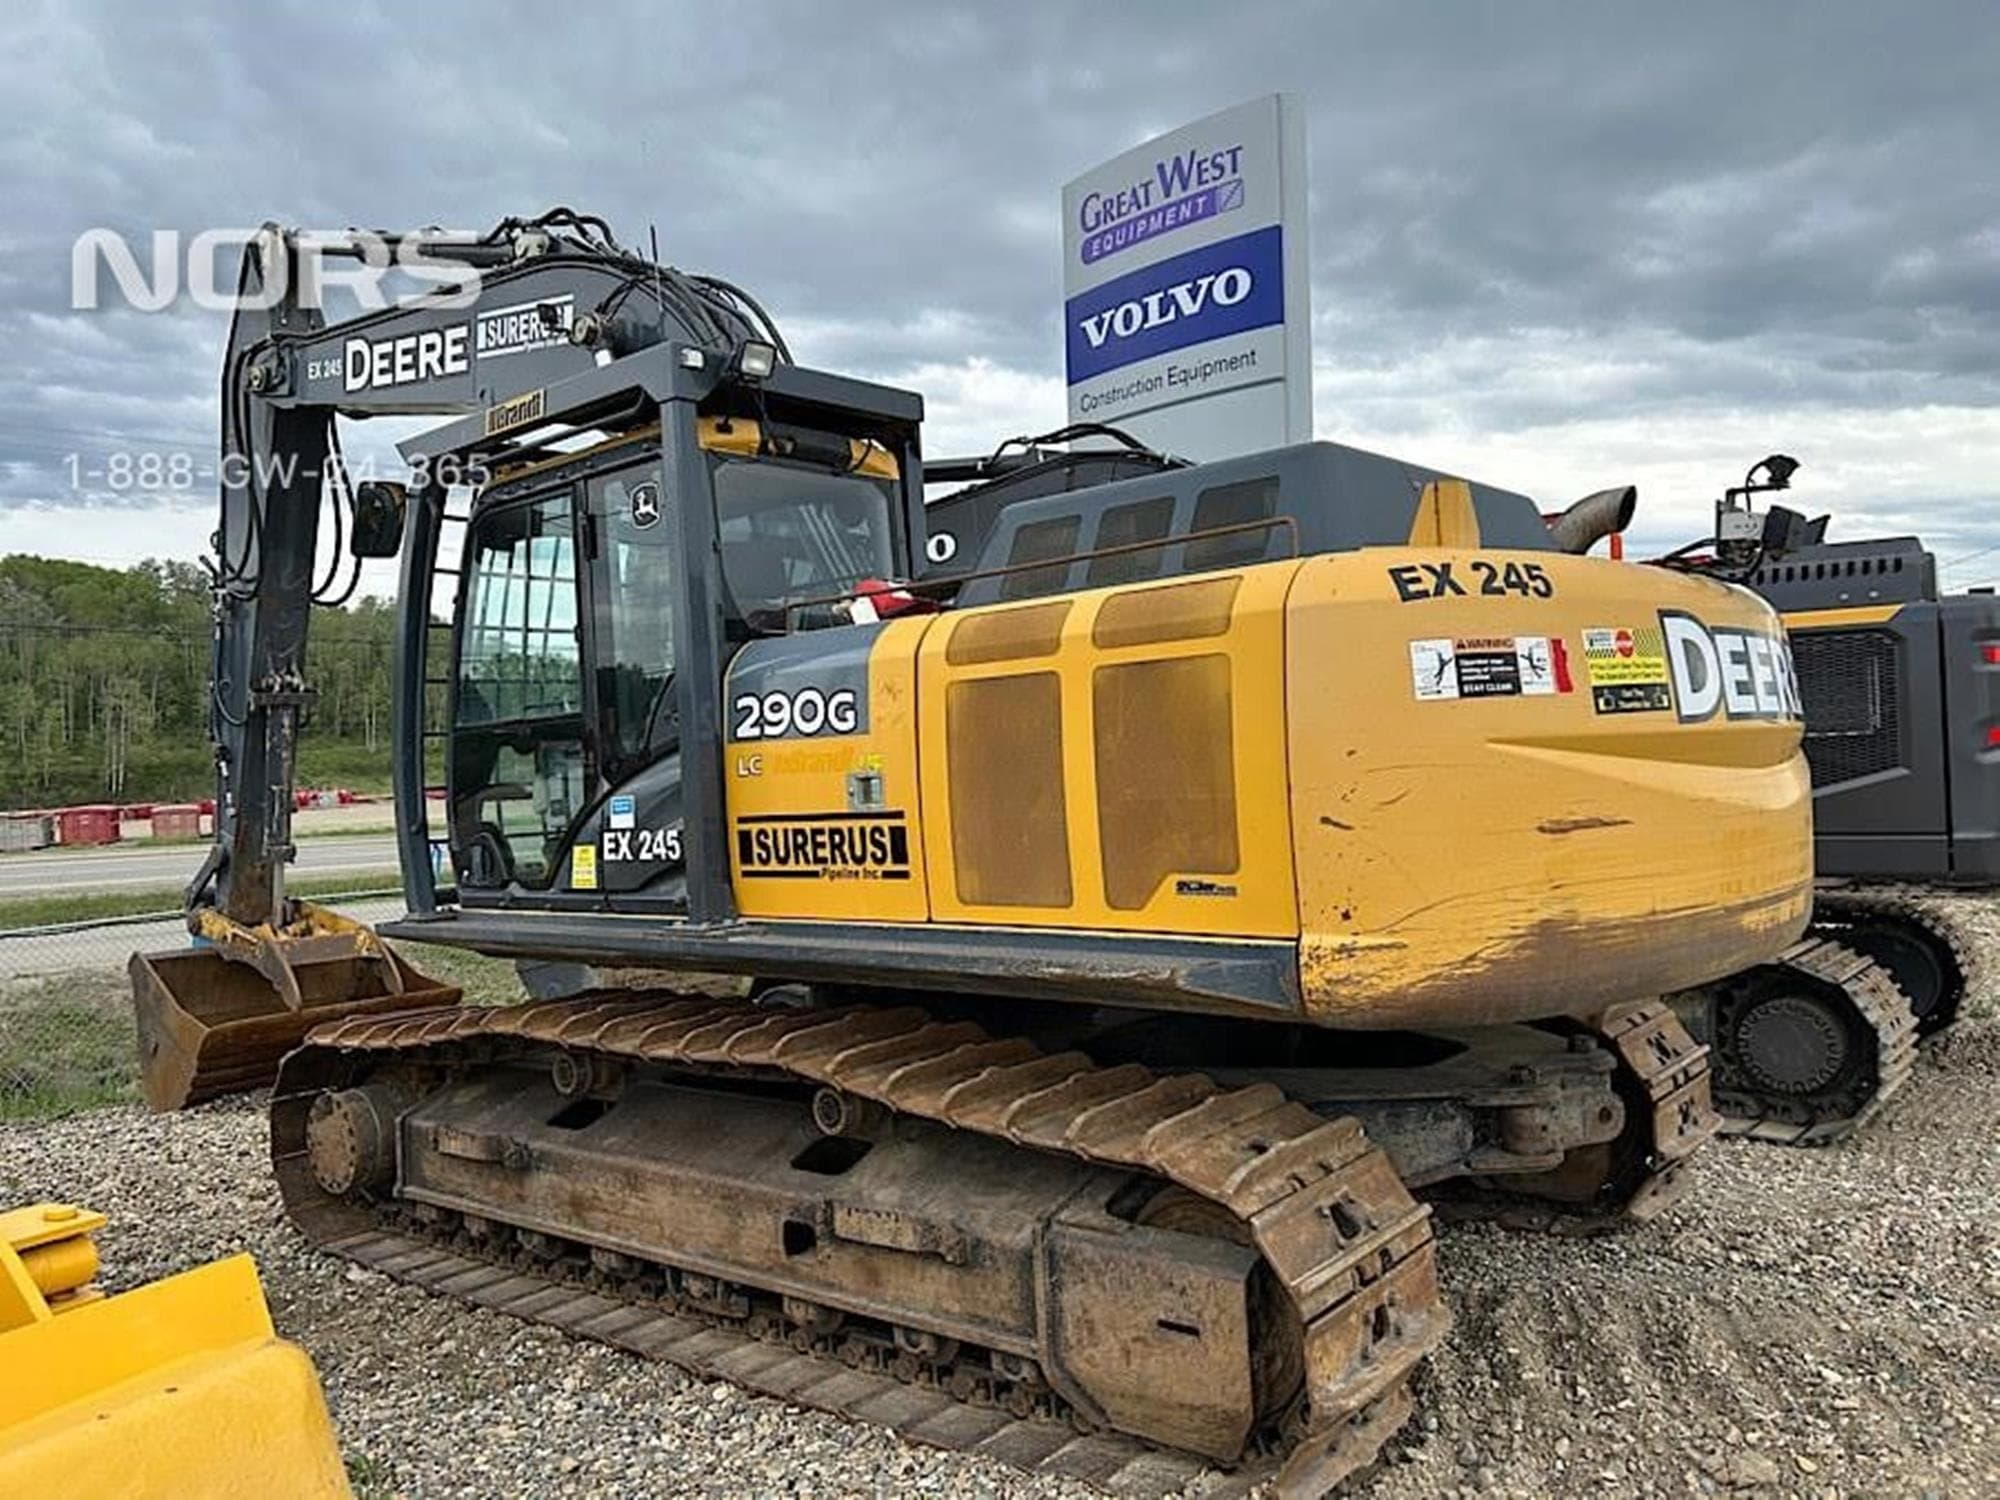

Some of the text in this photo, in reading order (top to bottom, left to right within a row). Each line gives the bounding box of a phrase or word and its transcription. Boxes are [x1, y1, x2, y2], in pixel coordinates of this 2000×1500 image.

[1091, 197, 1209, 257] EQUIPMENT
[1080, 268, 1252, 349] VOLVO
[308, 363, 321, 379] EX
[346, 325, 468, 391] DEERE
[1080, 349, 1257, 412] Construction Equipment
[1388, 561, 1553, 602] EX 245
[736, 687, 857, 739] 290G
[738, 755, 762, 777] LC
[603, 829, 681, 860] EX 245
[755, 826, 888, 866] SURERUS
